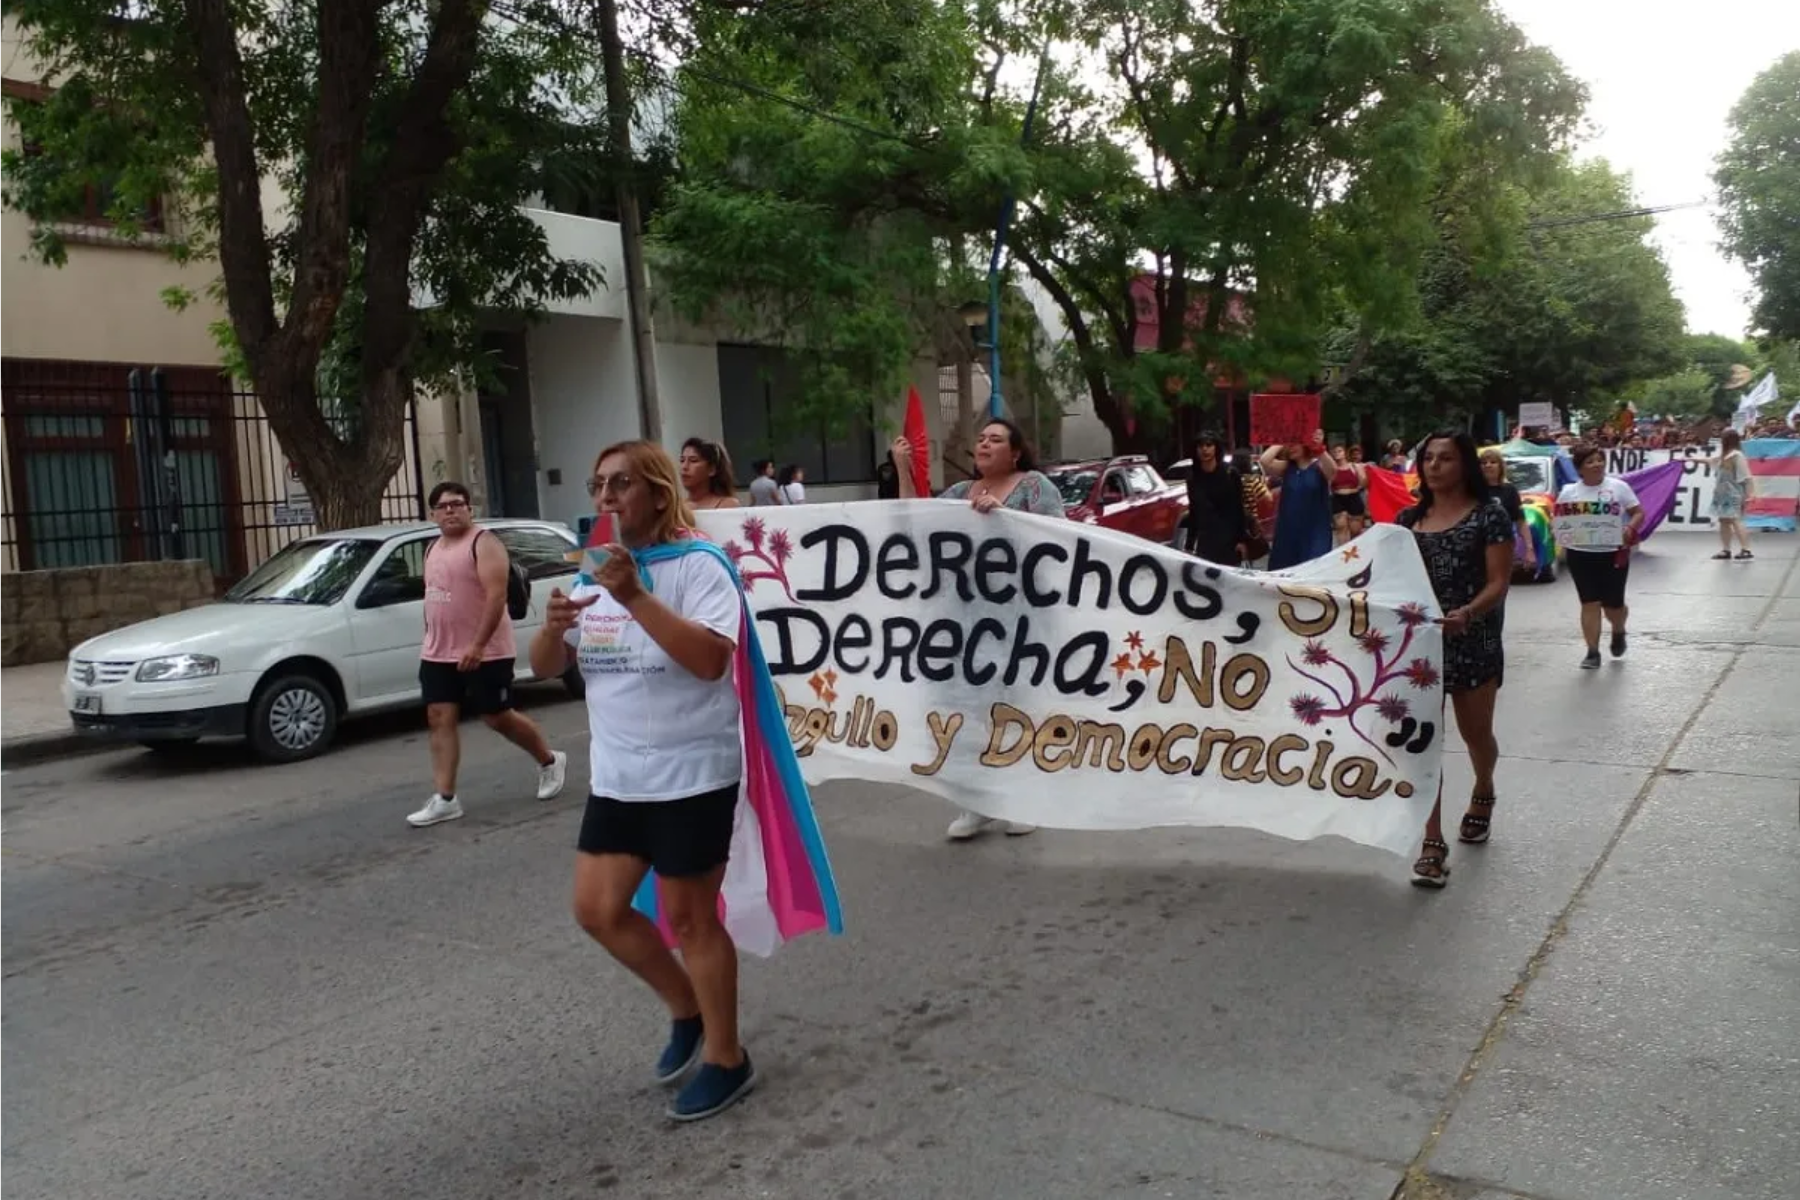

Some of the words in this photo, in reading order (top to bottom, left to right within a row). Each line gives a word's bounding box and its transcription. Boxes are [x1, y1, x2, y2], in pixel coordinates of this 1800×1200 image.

[1554, 502, 1620, 516] ABRAZOS
[1158, 634, 1271, 710] No
[775, 681, 898, 757] rgullo
[911, 711, 964, 775] y
